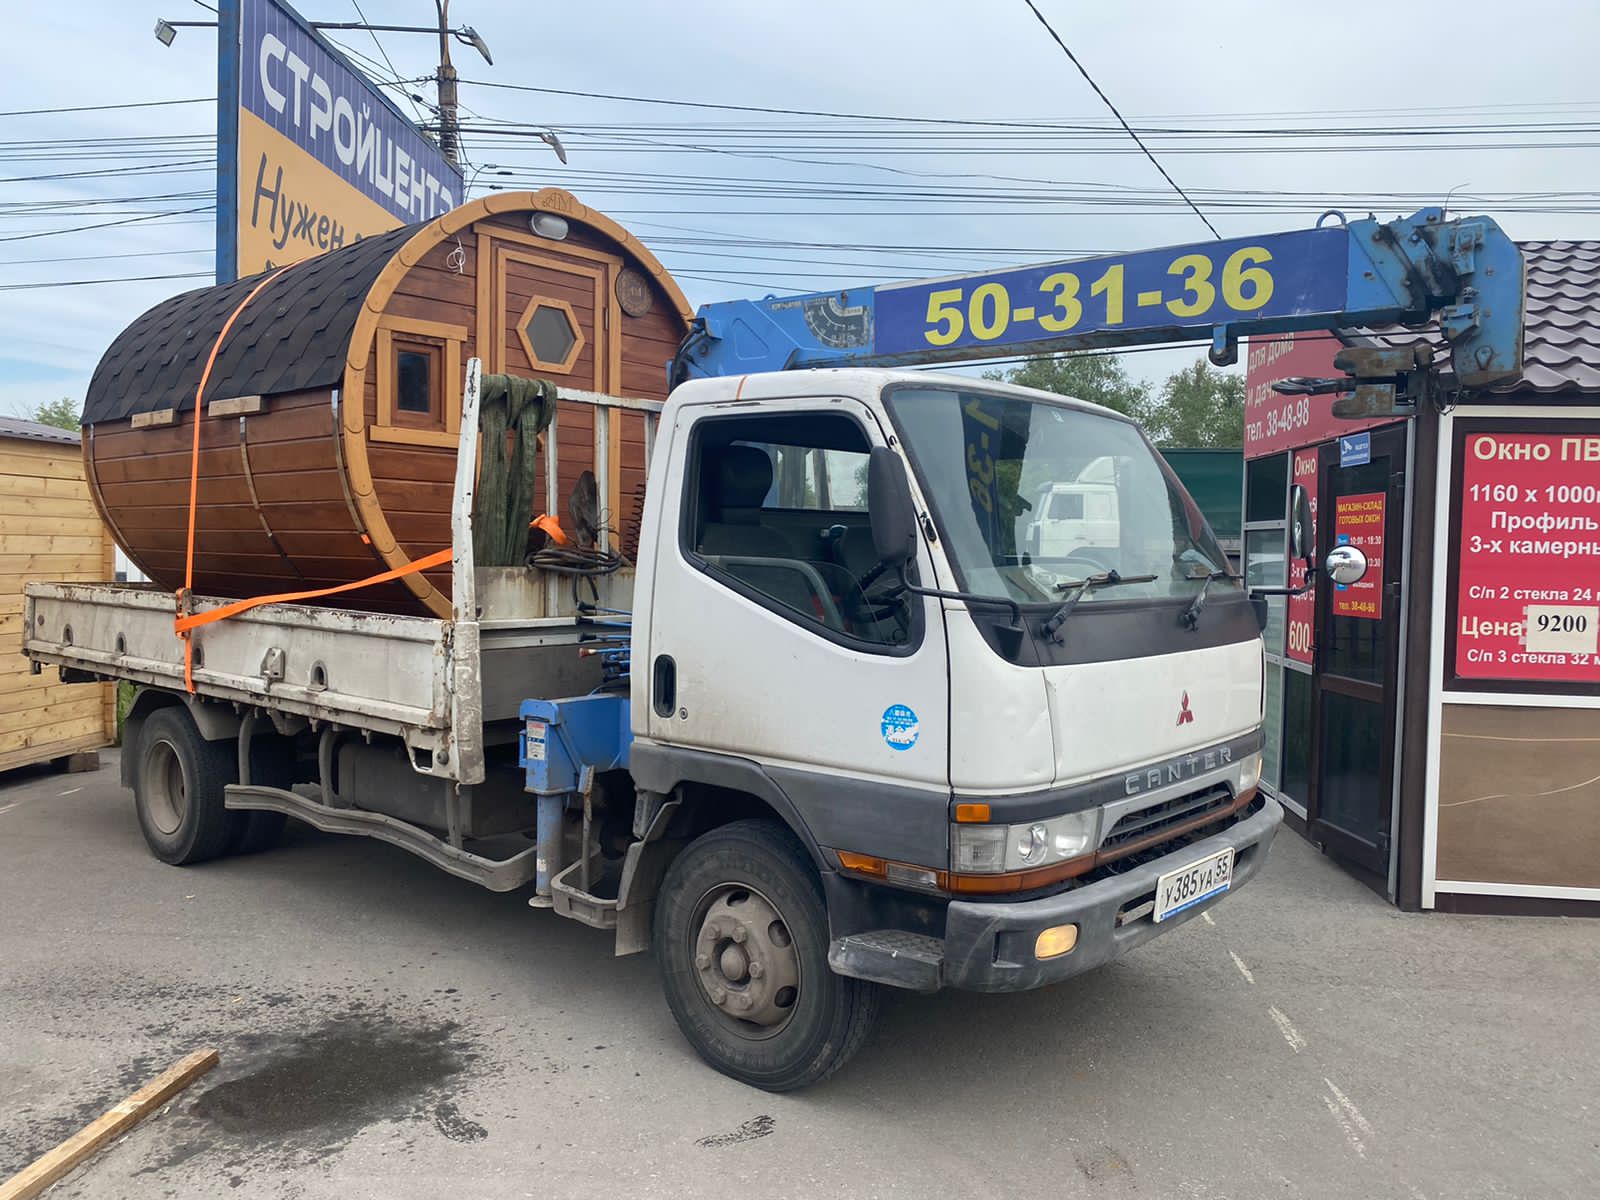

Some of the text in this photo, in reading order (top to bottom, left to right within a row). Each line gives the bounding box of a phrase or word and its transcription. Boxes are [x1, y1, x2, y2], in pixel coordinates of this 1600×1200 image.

[252, 152, 344, 250] Нужен
[923, 246, 1274, 347] 50-31-36
[1248, 332, 1295, 374] для дома
[1246, 398, 1310, 442] тел. 38-48-98
[1474, 436, 1551, 461] Окно
[1294, 456, 1316, 476] Окно
[1470, 484, 1518, 502] 1160
[1545, 485, 1600, 503] 1000
[1491, 511, 1599, 534] Профиль
[1470, 535, 1502, 553] 3-х
[1469, 586, 1495, 599] С/п
[1499, 587, 1509, 599] 2
[1513, 589, 1568, 600] стекла
[1573, 588, 1592, 601] 24
[1461, 616, 1522, 639] Цена
[1537, 615, 1587, 632] 9200
[1289, 620, 1310, 654] 600
[1467, 649, 1493, 662] С/п
[1498, 650, 1507, 663] 3
[1511, 653, 1566, 664] стекла
[1571, 653, 1589, 665] 32
[1125, 746, 1232, 795] CANTER
